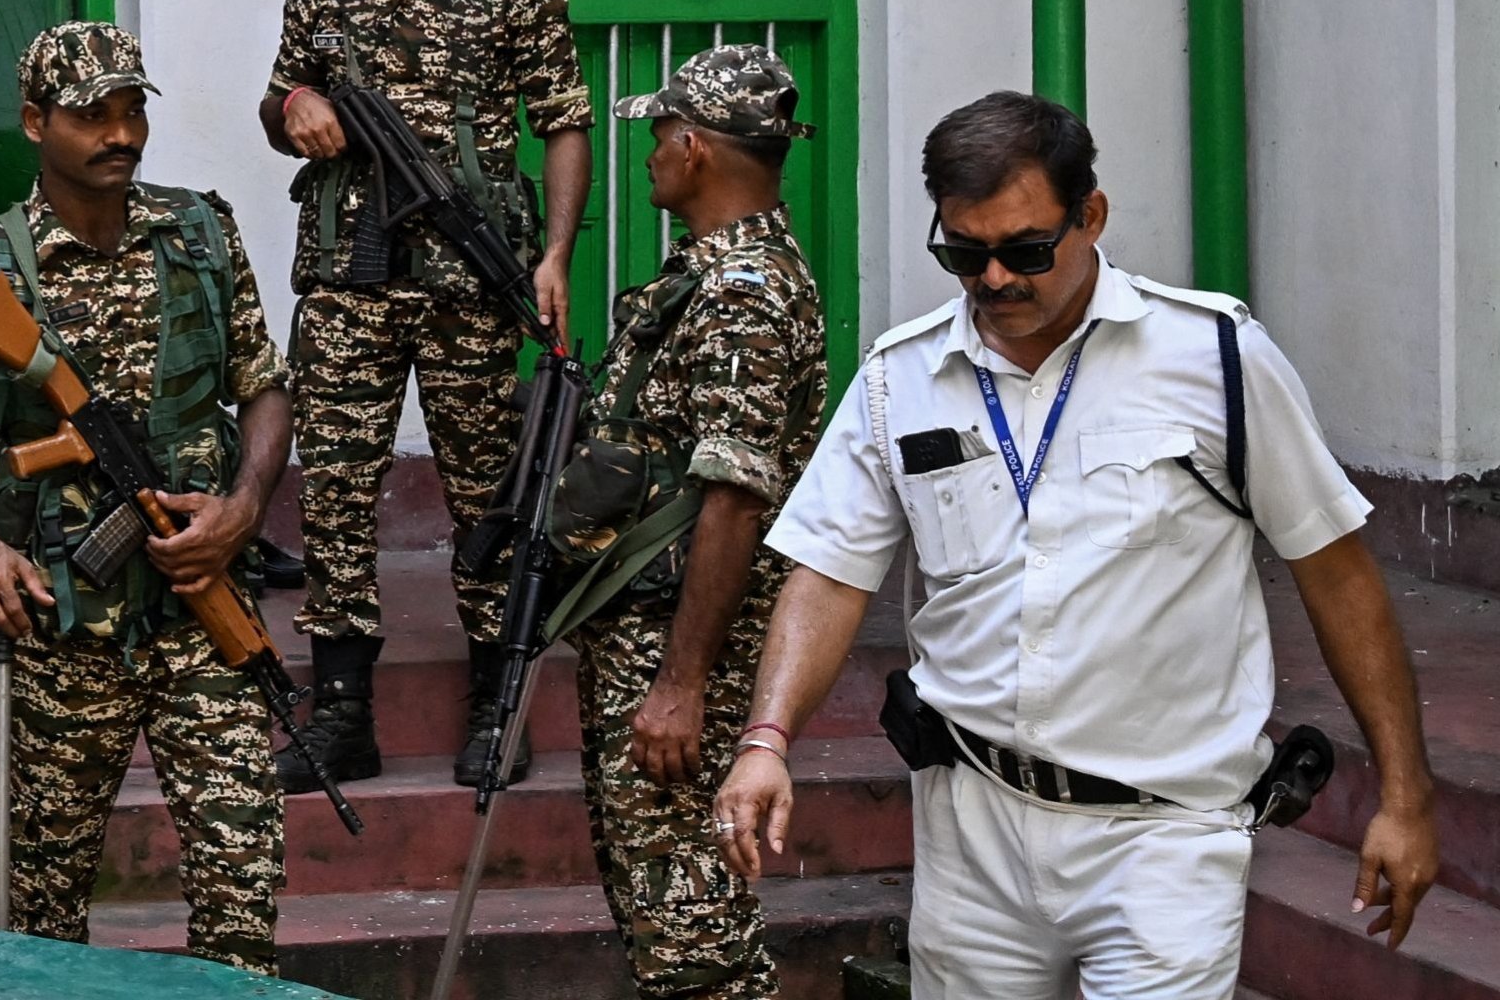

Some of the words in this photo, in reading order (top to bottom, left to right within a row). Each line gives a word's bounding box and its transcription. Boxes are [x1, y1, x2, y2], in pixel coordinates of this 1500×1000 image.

[1062, 354, 1079, 391] KOLKATA
[1001, 439, 1020, 470] POLICE
[1033, 439, 1049, 469] POLICE
